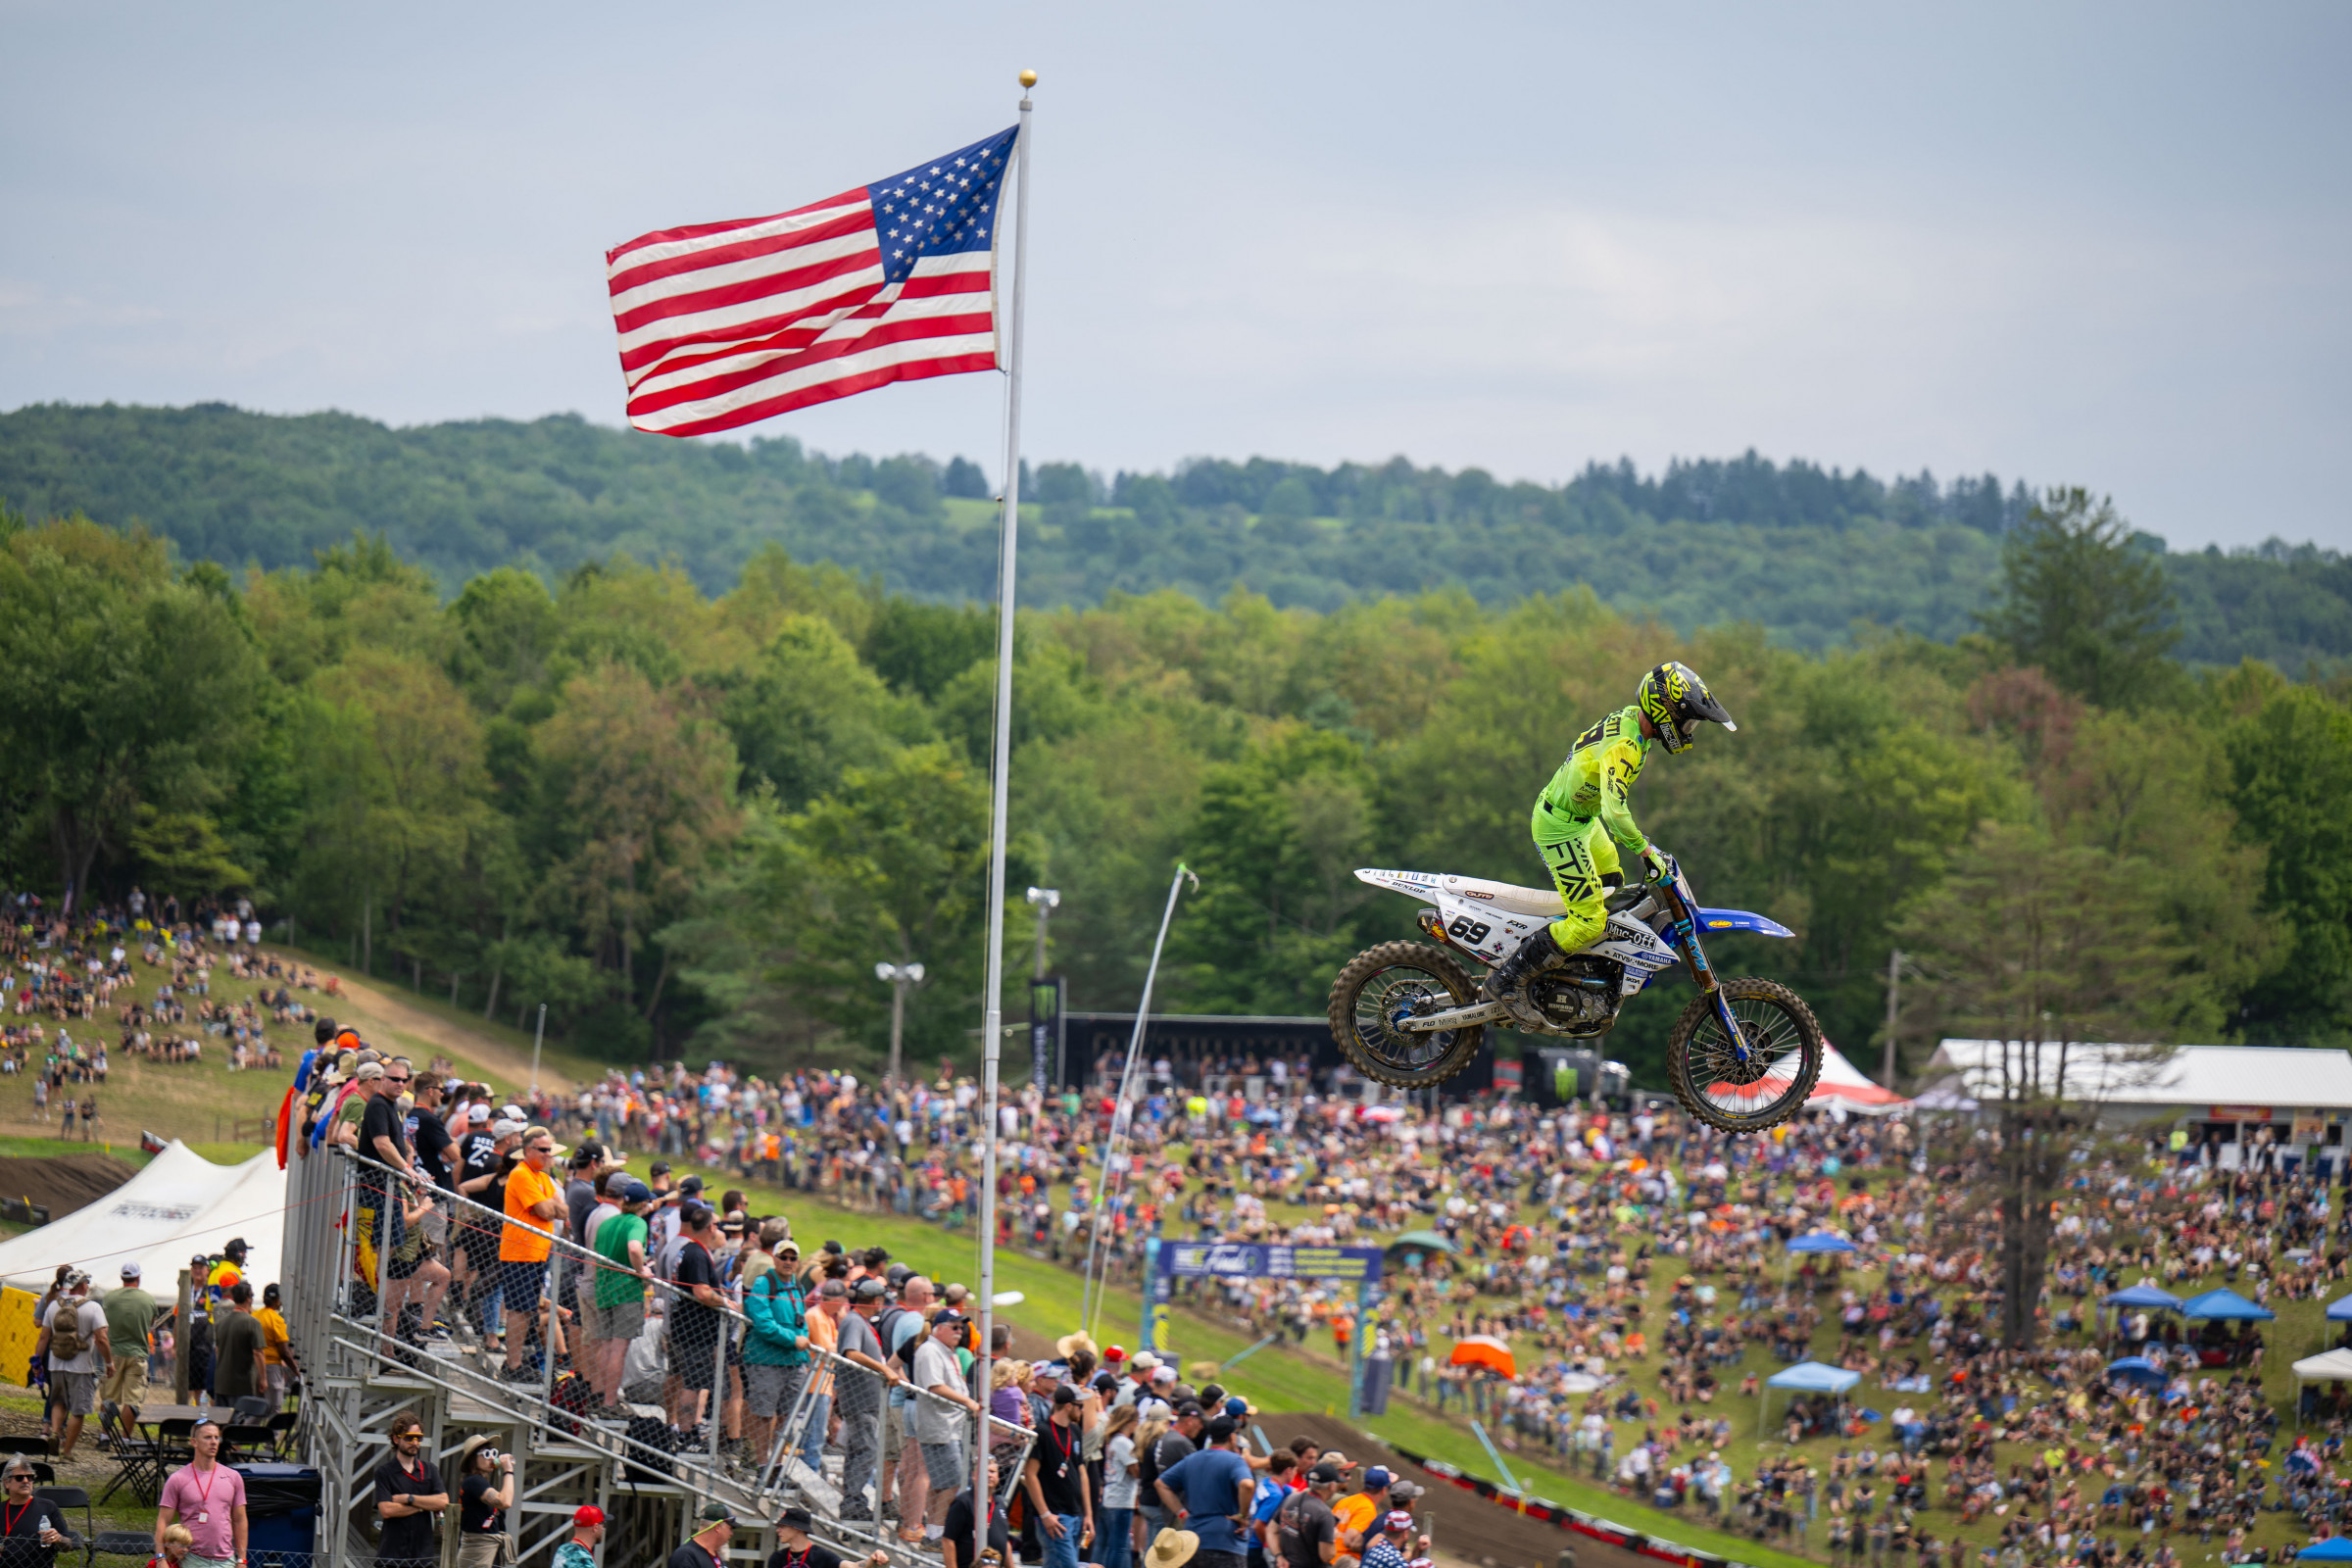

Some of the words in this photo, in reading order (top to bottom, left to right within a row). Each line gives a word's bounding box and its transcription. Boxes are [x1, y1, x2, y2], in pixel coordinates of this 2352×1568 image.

[1392, 881, 1426, 894] DUNLOP
[1448, 915, 1492, 946] 69
[1506, 919, 1528, 930] FXR
[1609, 922, 1656, 951] Muc-Off
[1648, 954, 1672, 965] YAMAHA
[1686, 935, 1707, 971] KYB
[1461, 1009, 1486, 1021] YAMALUBE
